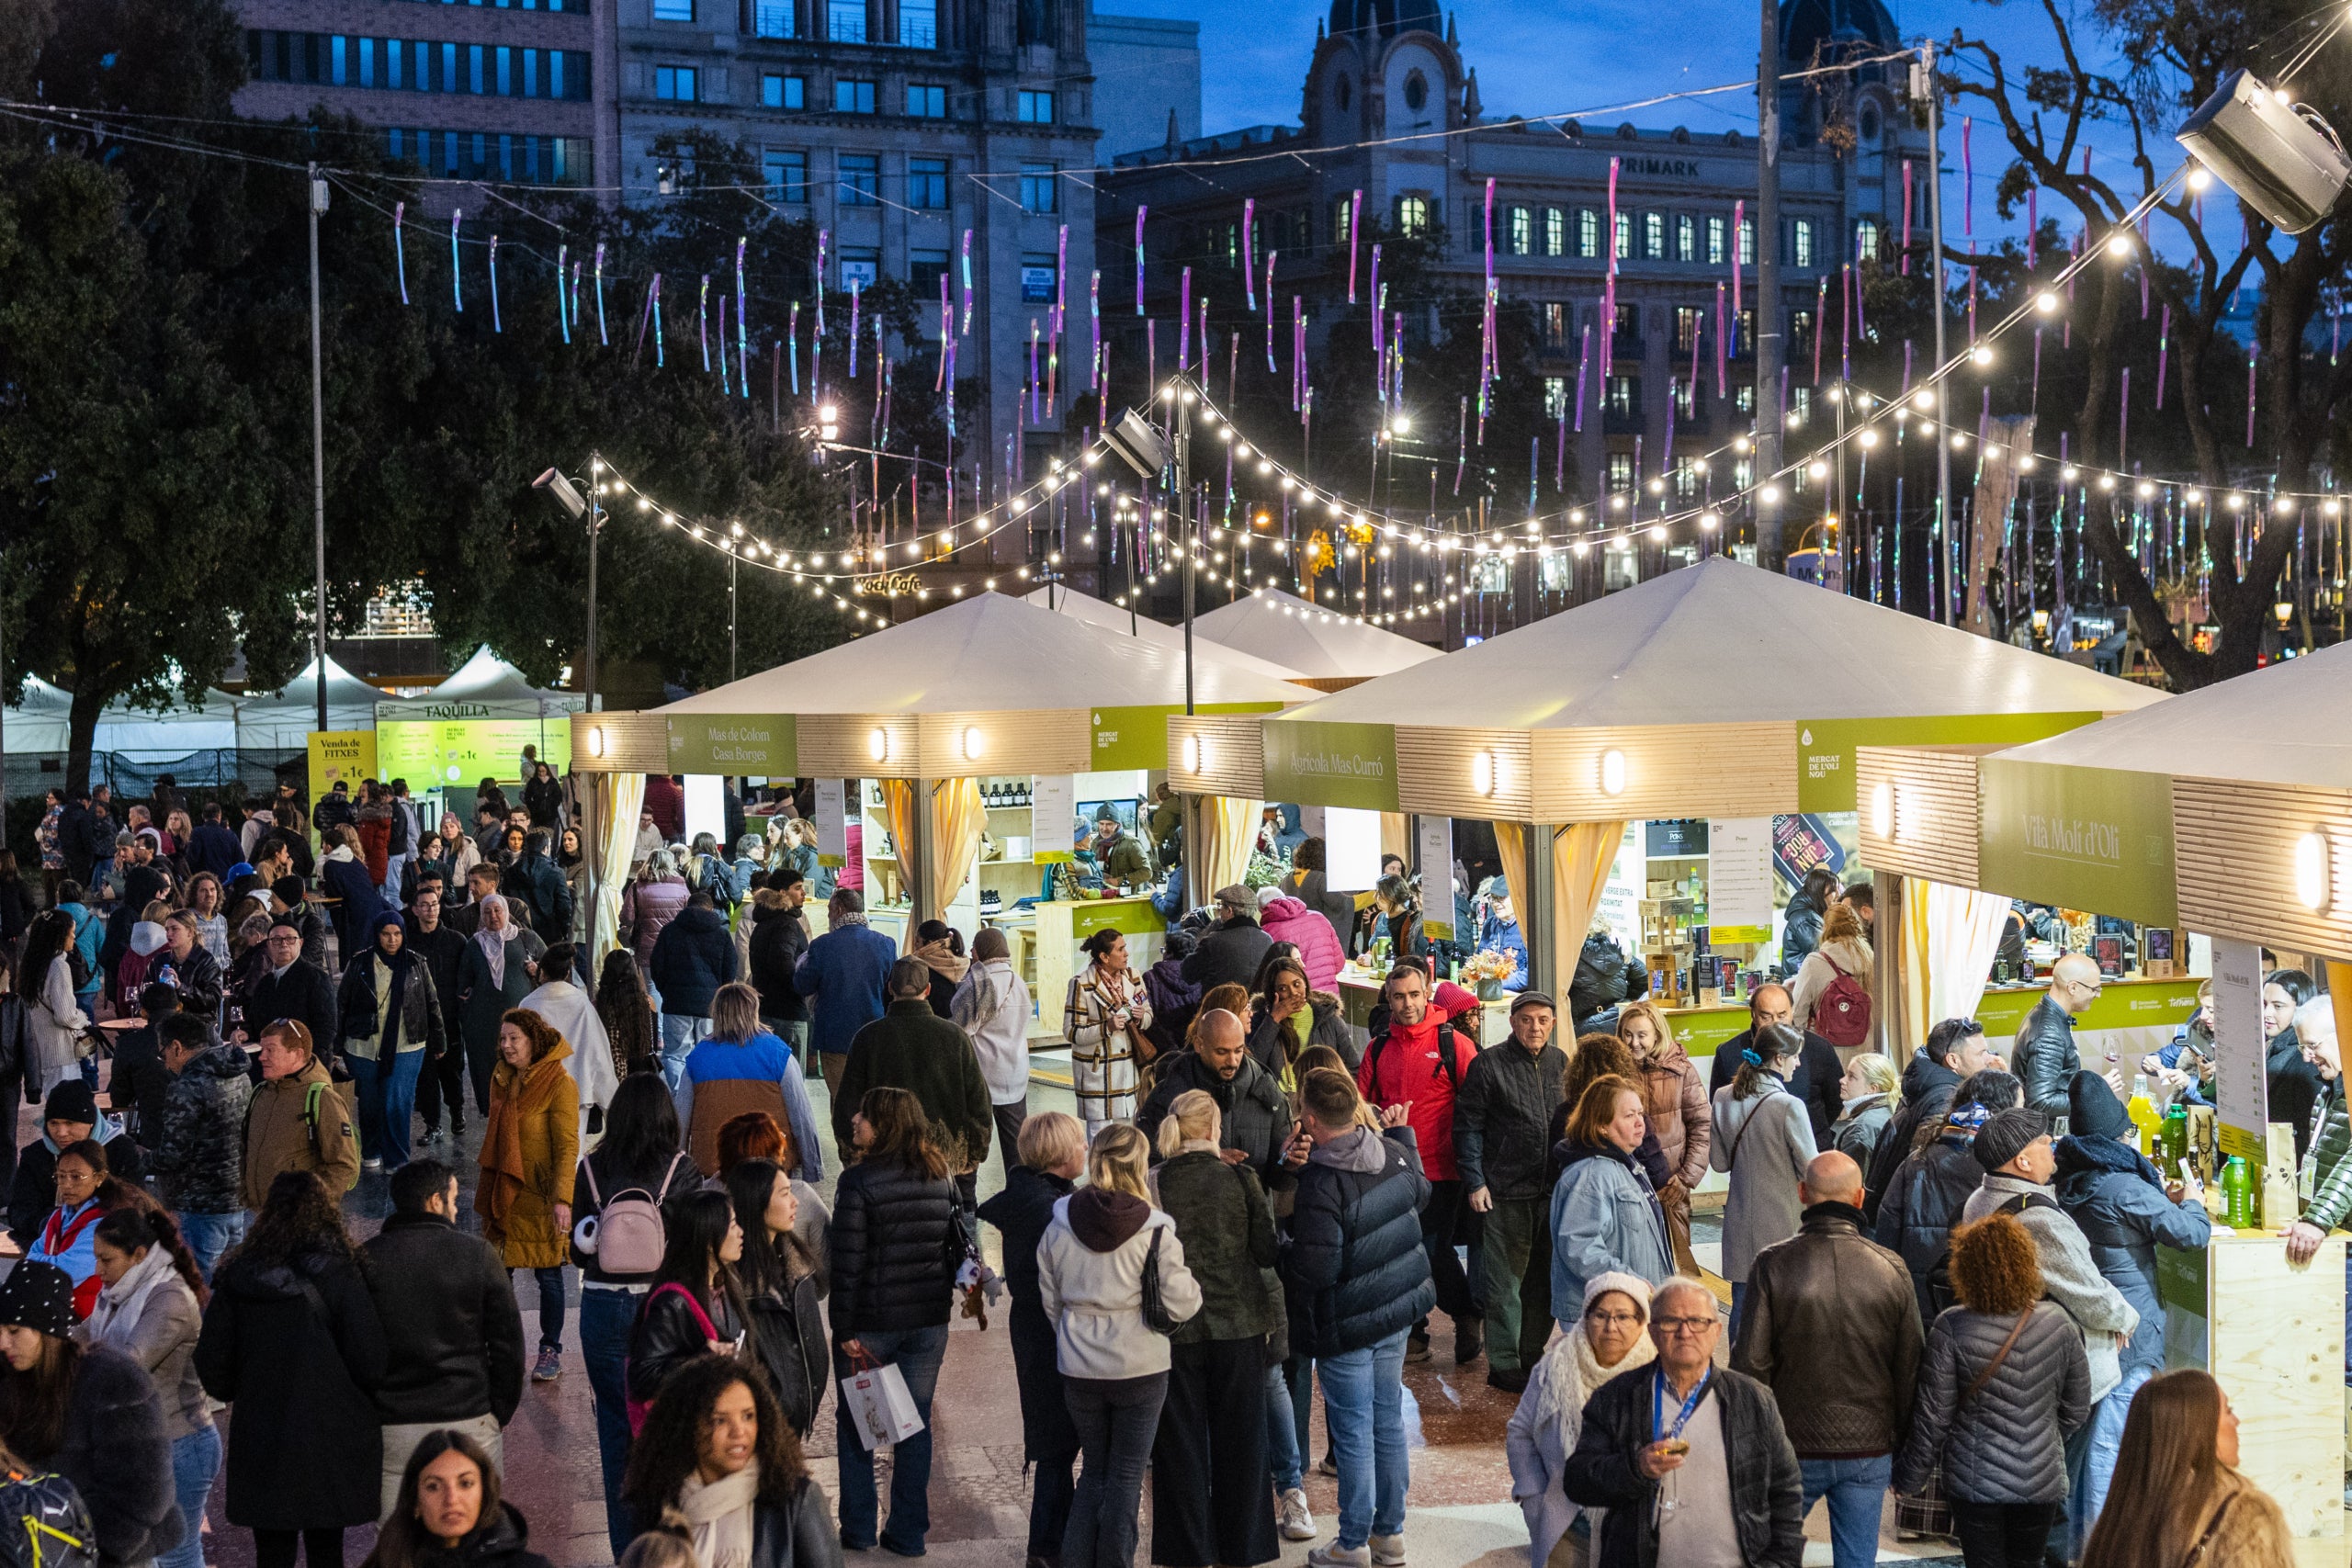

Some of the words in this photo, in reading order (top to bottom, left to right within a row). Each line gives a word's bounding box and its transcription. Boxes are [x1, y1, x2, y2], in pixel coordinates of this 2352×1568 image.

[424, 705, 490, 719] TAQUILLA
[708, 728, 726, 740] Mas
[728, 728, 739, 741] de
[740, 728, 770, 742] Colom
[320, 739, 349, 749] Venda
[350, 739, 360, 748] de
[324, 749, 359, 759] FITXES
[712, 746, 734, 761] Casa
[736, 747, 767, 763] Borges
[1808, 755, 1840, 763] MERCAT
[1291, 750, 1329, 774] Agrícola
[1330, 753, 1352, 773] Mas
[1352, 753, 1384, 776] Curró
[2021, 814, 2049, 850] Vilà
[2051, 818, 2082, 855] Molí
[1794, 844, 1820, 873] JAN
[1605, 886, 1619, 896] VERGE
[1620, 887, 1634, 897] EXTRA
[1600, 897, 1623, 907] ROXIMITAT
